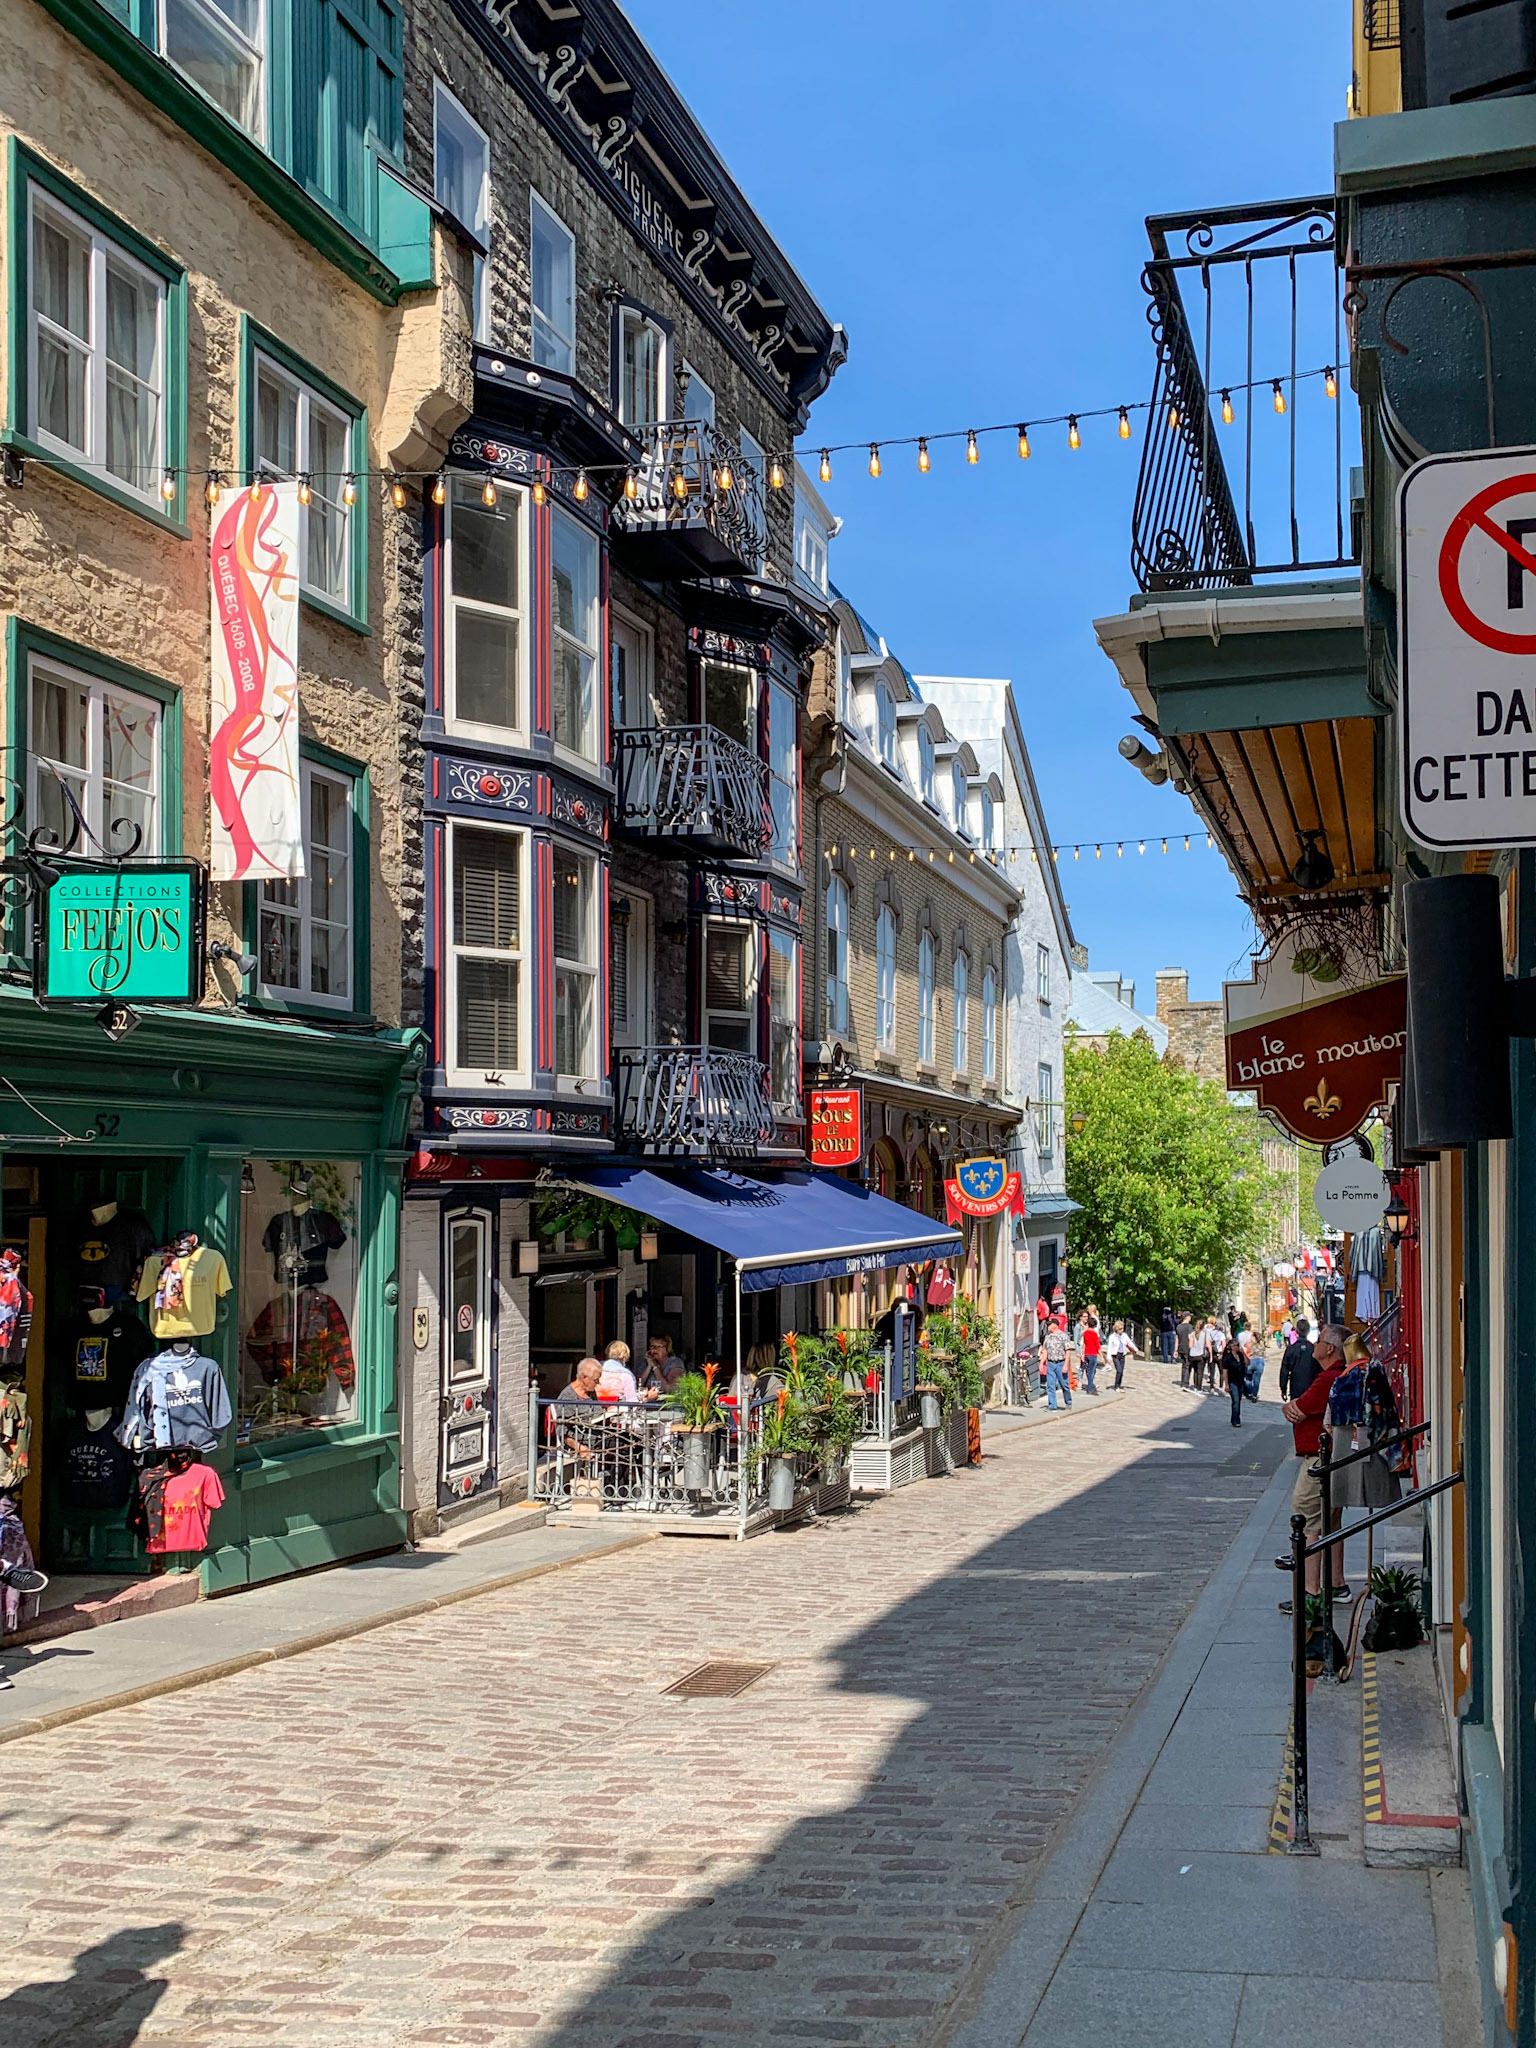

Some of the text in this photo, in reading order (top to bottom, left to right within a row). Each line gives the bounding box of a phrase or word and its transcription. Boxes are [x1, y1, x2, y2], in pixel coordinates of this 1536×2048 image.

[633, 203, 664, 250] PROP
[217, 554, 239, 615] QUÉBEC
[1477, 688, 1536, 737] DA
[59, 886, 181, 897] COLLECTIONS
[111, 1010, 128, 1030] 52
[1261, 1036, 1285, 1055] le
[1237, 1052, 1305, 1082] blanc
[95, 1114, 120, 1137] 52
[811, 1109, 853, 1125] SOUS
[826, 1125, 839, 1136] LE
[811, 1137, 856, 1153] FORT
[948, 1176, 1017, 1213] SOUVENIRS DU LYS
[1326, 1190, 1379, 1200] La Pomme
[70, 1444, 107, 1456] QUÉBEC
